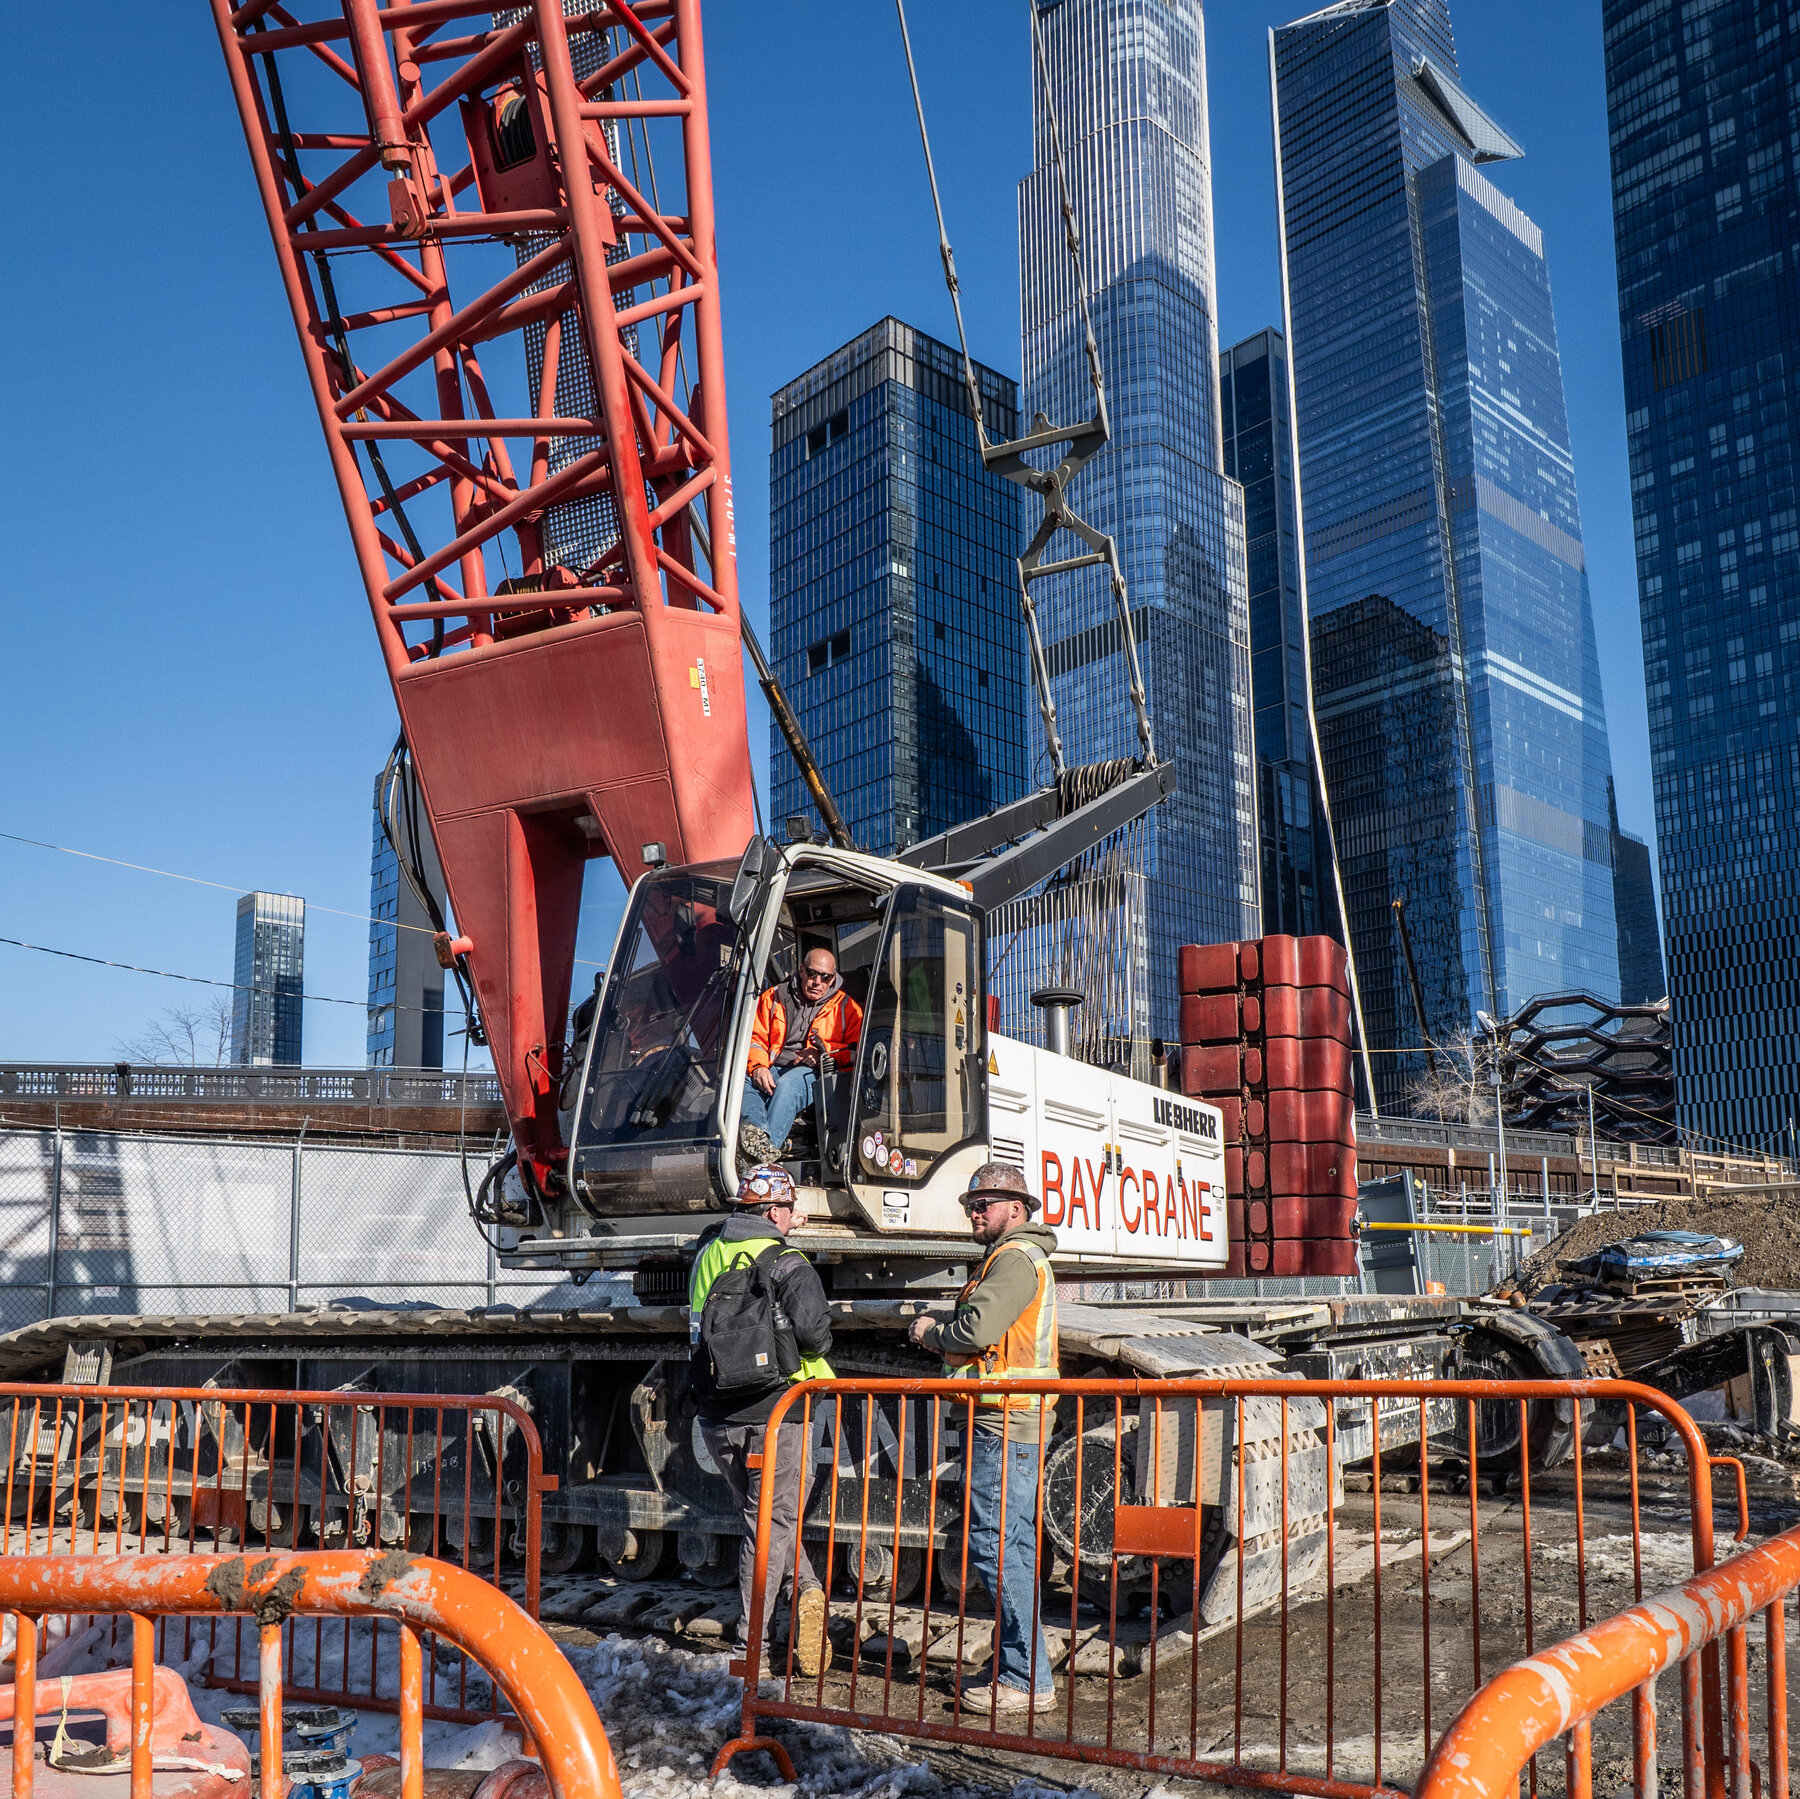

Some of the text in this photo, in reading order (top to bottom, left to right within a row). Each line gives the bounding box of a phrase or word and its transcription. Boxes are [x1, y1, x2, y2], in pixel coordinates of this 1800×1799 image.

[1153, 1097, 1217, 1140] LIEBHERR
[1042, 1150, 1214, 1242] BAY CRANE
